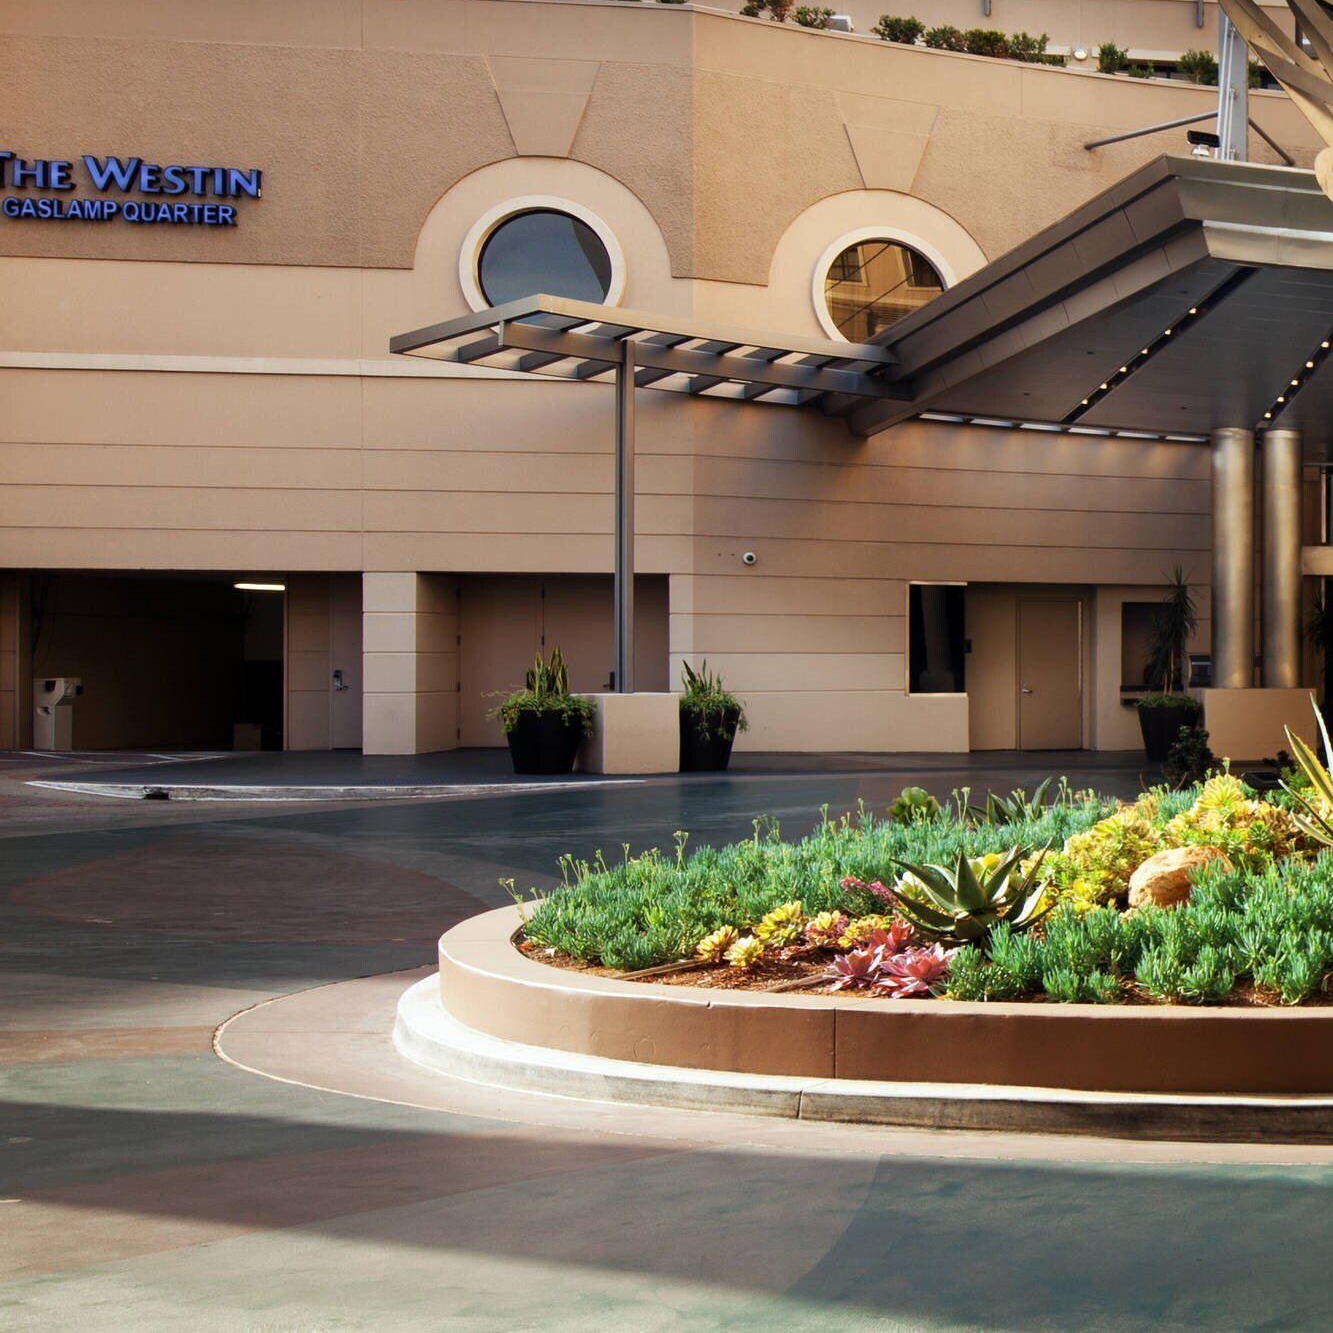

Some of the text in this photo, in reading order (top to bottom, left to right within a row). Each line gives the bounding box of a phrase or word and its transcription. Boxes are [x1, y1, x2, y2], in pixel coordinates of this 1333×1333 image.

[82, 155, 261, 198] WESTIN
[2, 196, 236, 226] GASLAMP QUARTER
